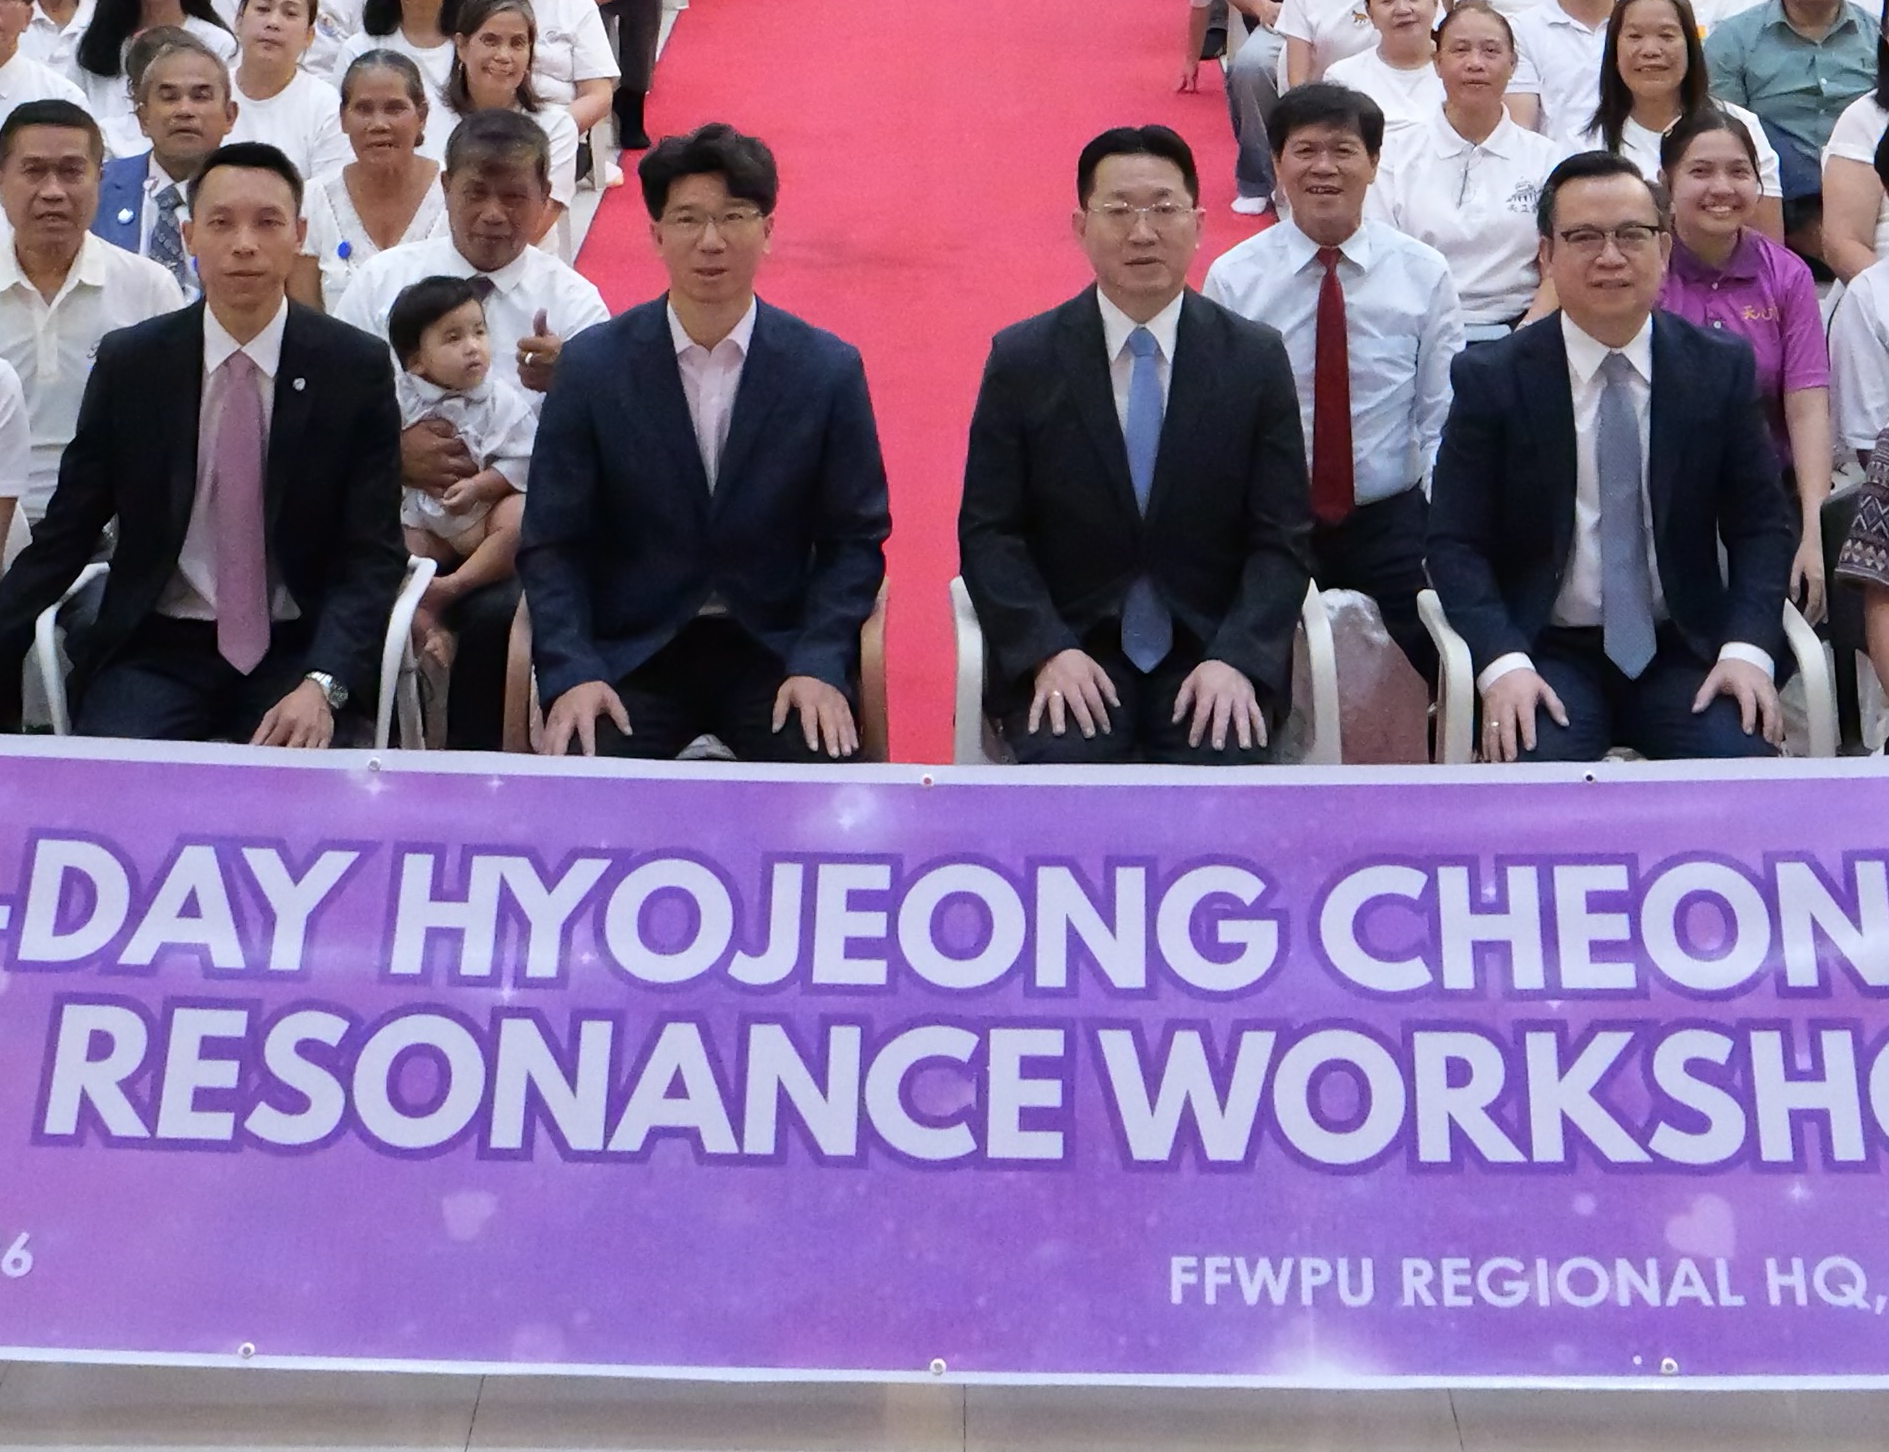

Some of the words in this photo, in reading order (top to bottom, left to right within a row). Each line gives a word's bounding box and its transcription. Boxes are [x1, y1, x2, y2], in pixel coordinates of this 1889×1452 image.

[385, 853, 1284, 991] HYOJEONG
[44, 1004, 1065, 1160] RESONANCE
[1169, 1255, 1376, 1308] FFWPU
[1400, 1255, 1745, 1308] REGIONAL
[1766, 1255, 1887, 1316] HQ,
